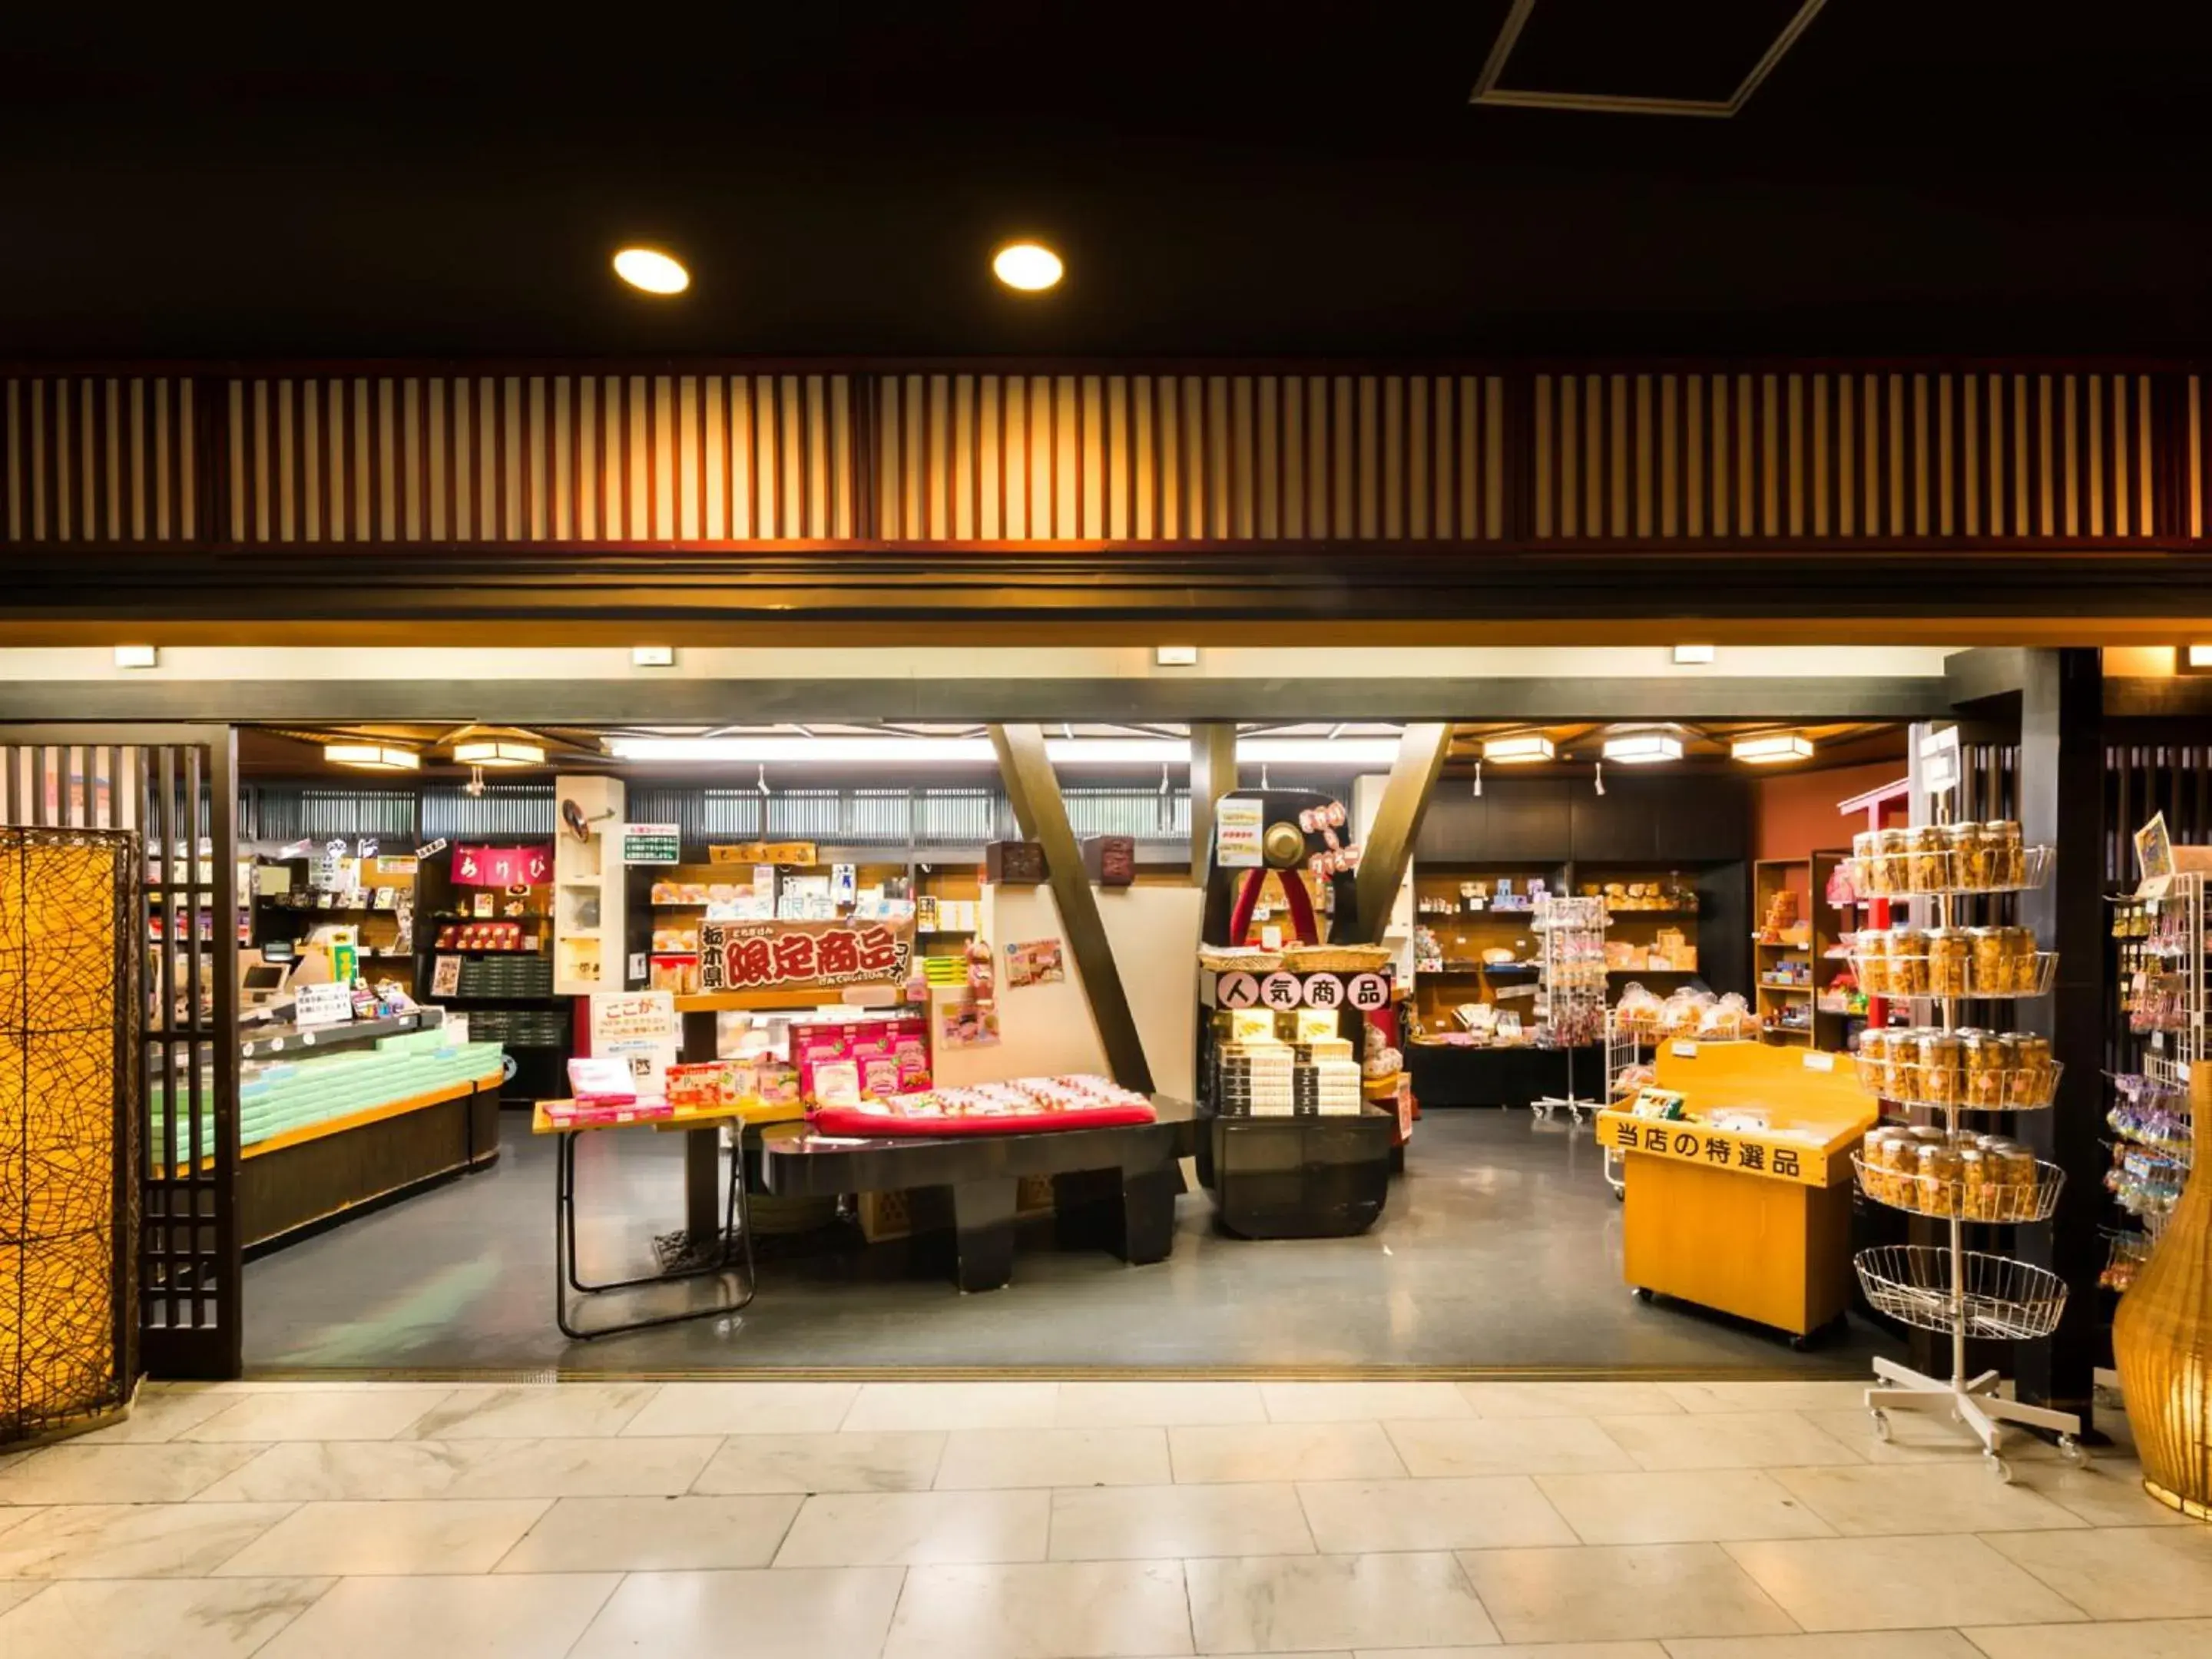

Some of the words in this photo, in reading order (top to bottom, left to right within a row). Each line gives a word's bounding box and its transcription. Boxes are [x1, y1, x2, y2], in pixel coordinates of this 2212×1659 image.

[703, 926, 723, 987] 栃木県
[727, 926, 896, 986] 限定商品
[1227, 978, 1381, 1005] 人気商品
[1617, 1121, 1800, 1177] 当店の特選品
